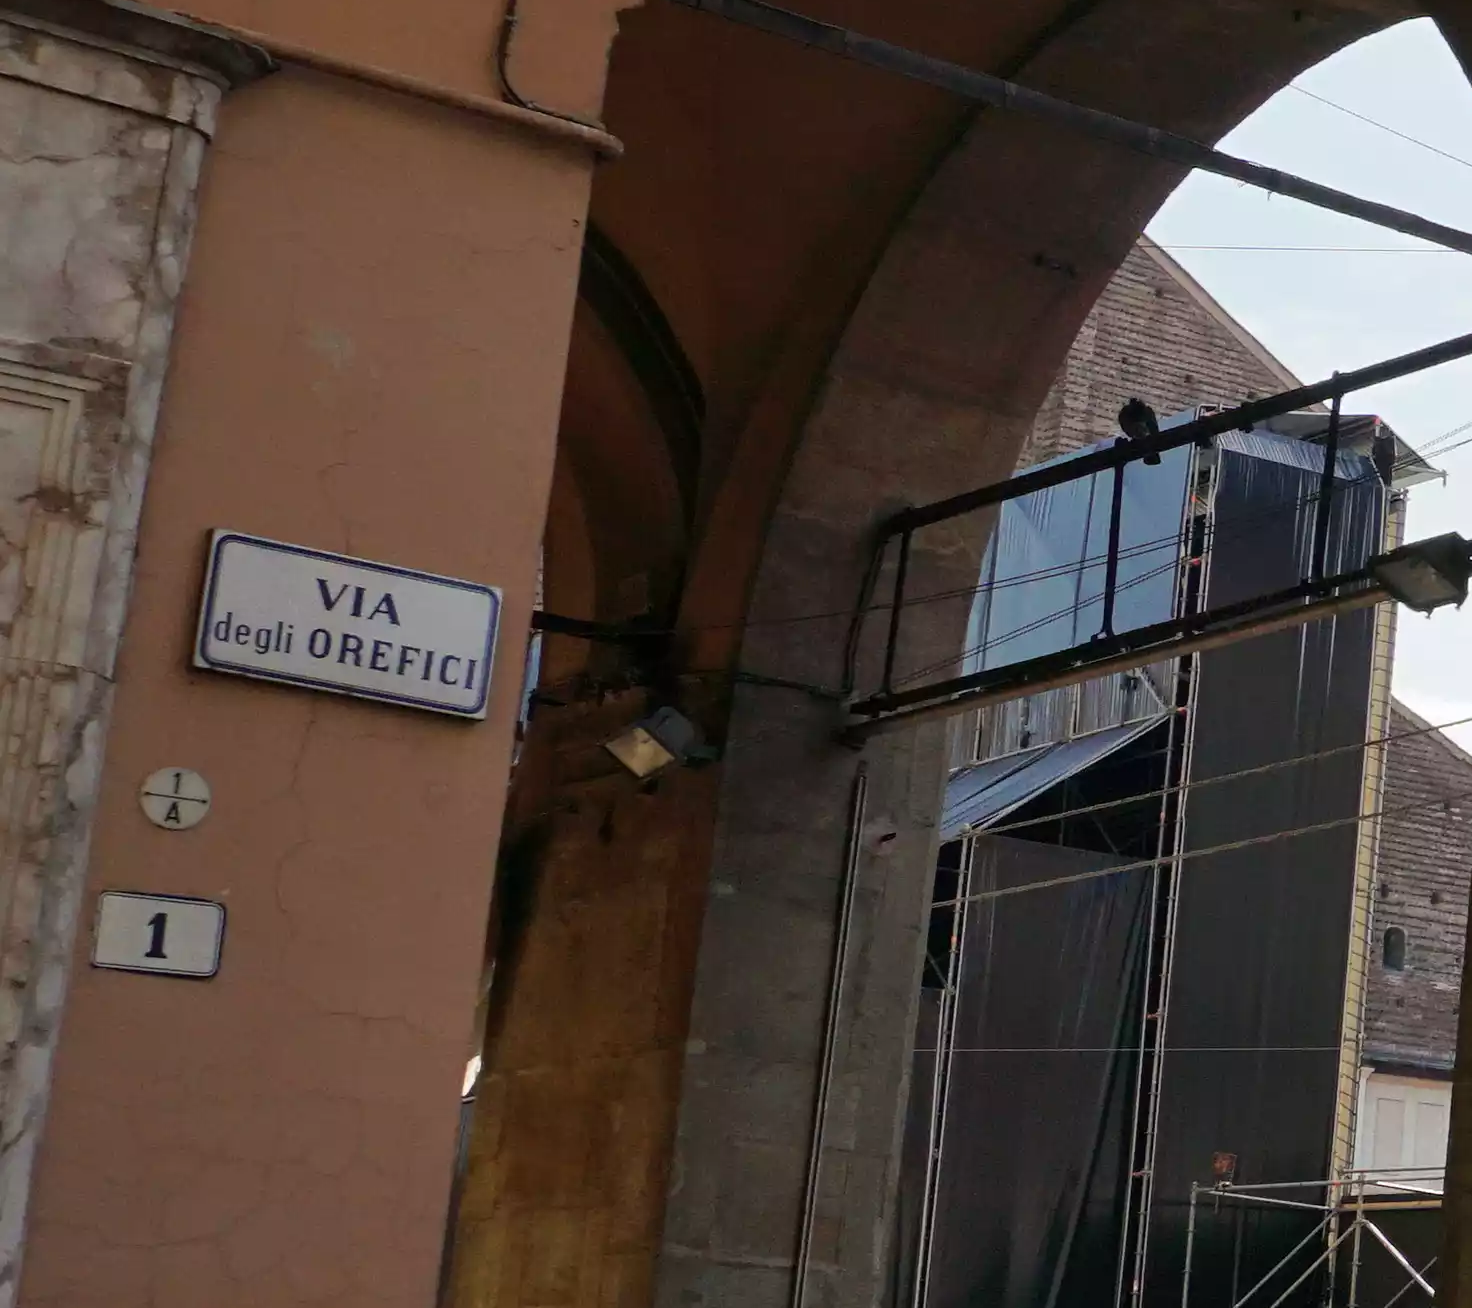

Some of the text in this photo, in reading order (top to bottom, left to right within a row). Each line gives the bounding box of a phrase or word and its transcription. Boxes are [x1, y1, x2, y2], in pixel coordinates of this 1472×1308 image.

[317, 578, 400, 626] VIA
[214, 612, 478, 690] degli OREFICI
[171, 772, 182, 794] 1
[164, 801, 181, 824] A
[144, 912, 168, 959] 1
